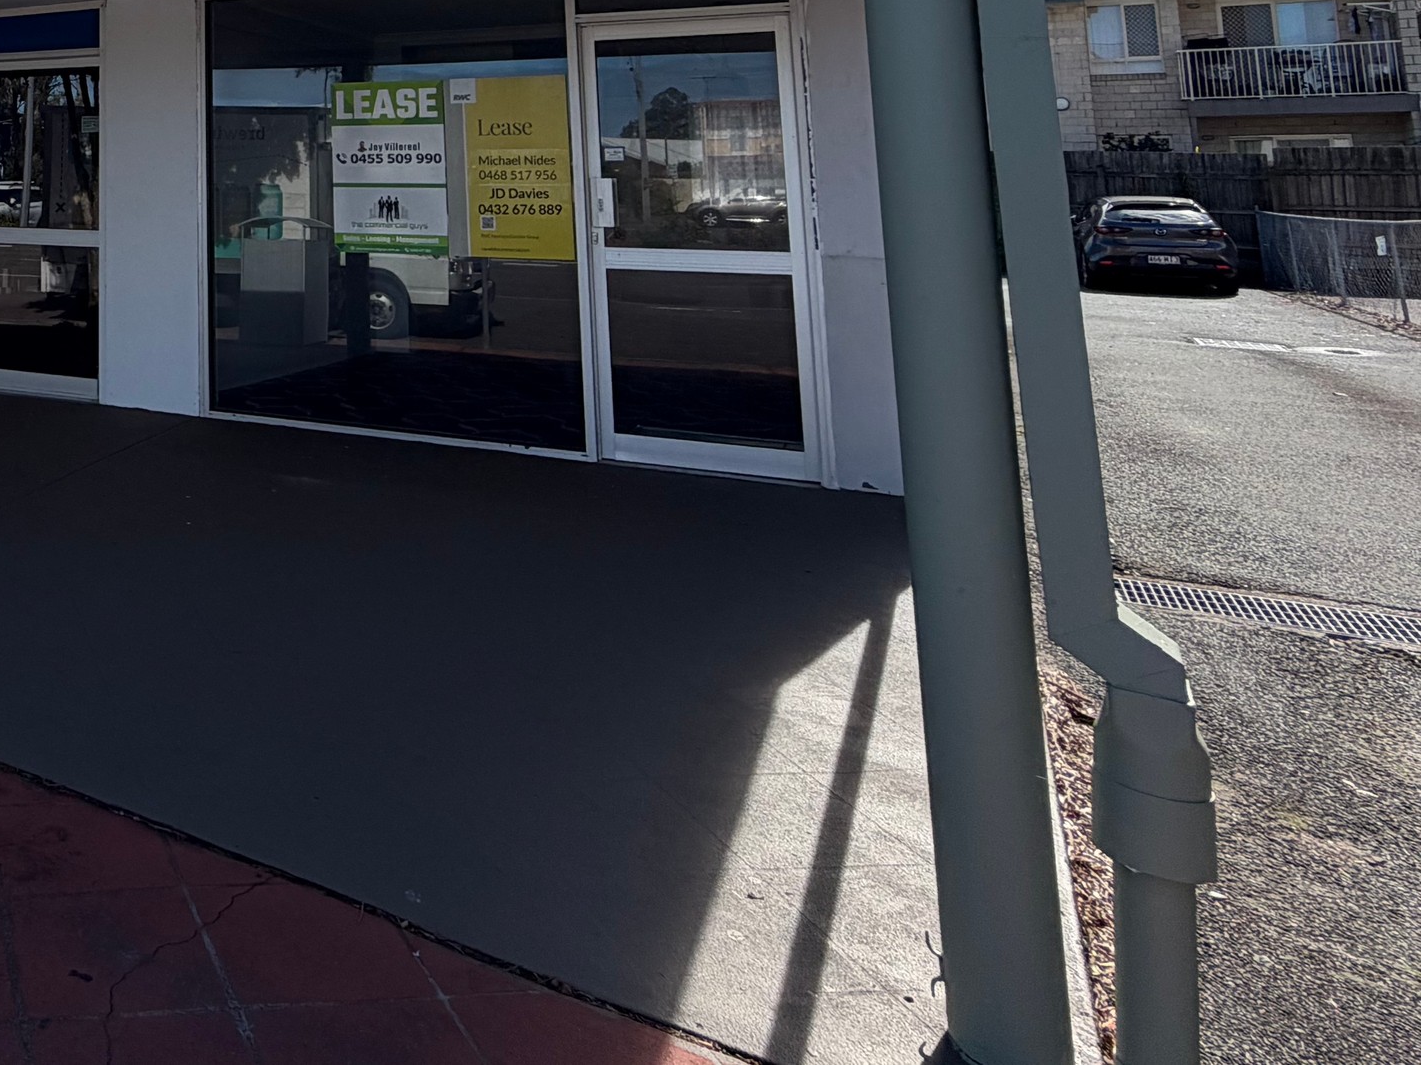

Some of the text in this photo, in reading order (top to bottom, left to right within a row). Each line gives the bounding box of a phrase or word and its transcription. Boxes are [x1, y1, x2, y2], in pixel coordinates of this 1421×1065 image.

[335, 87, 439, 120] LEASE
[477, 118, 533, 136] Lease
[350, 153, 442, 164] 0455 509 990
[478, 155, 557, 166] Michael Nides
[478, 170, 557, 181] 0468 517 956
[489, 187, 550, 199] JD Davies
[478, 204, 562, 215] 0432 676 889
